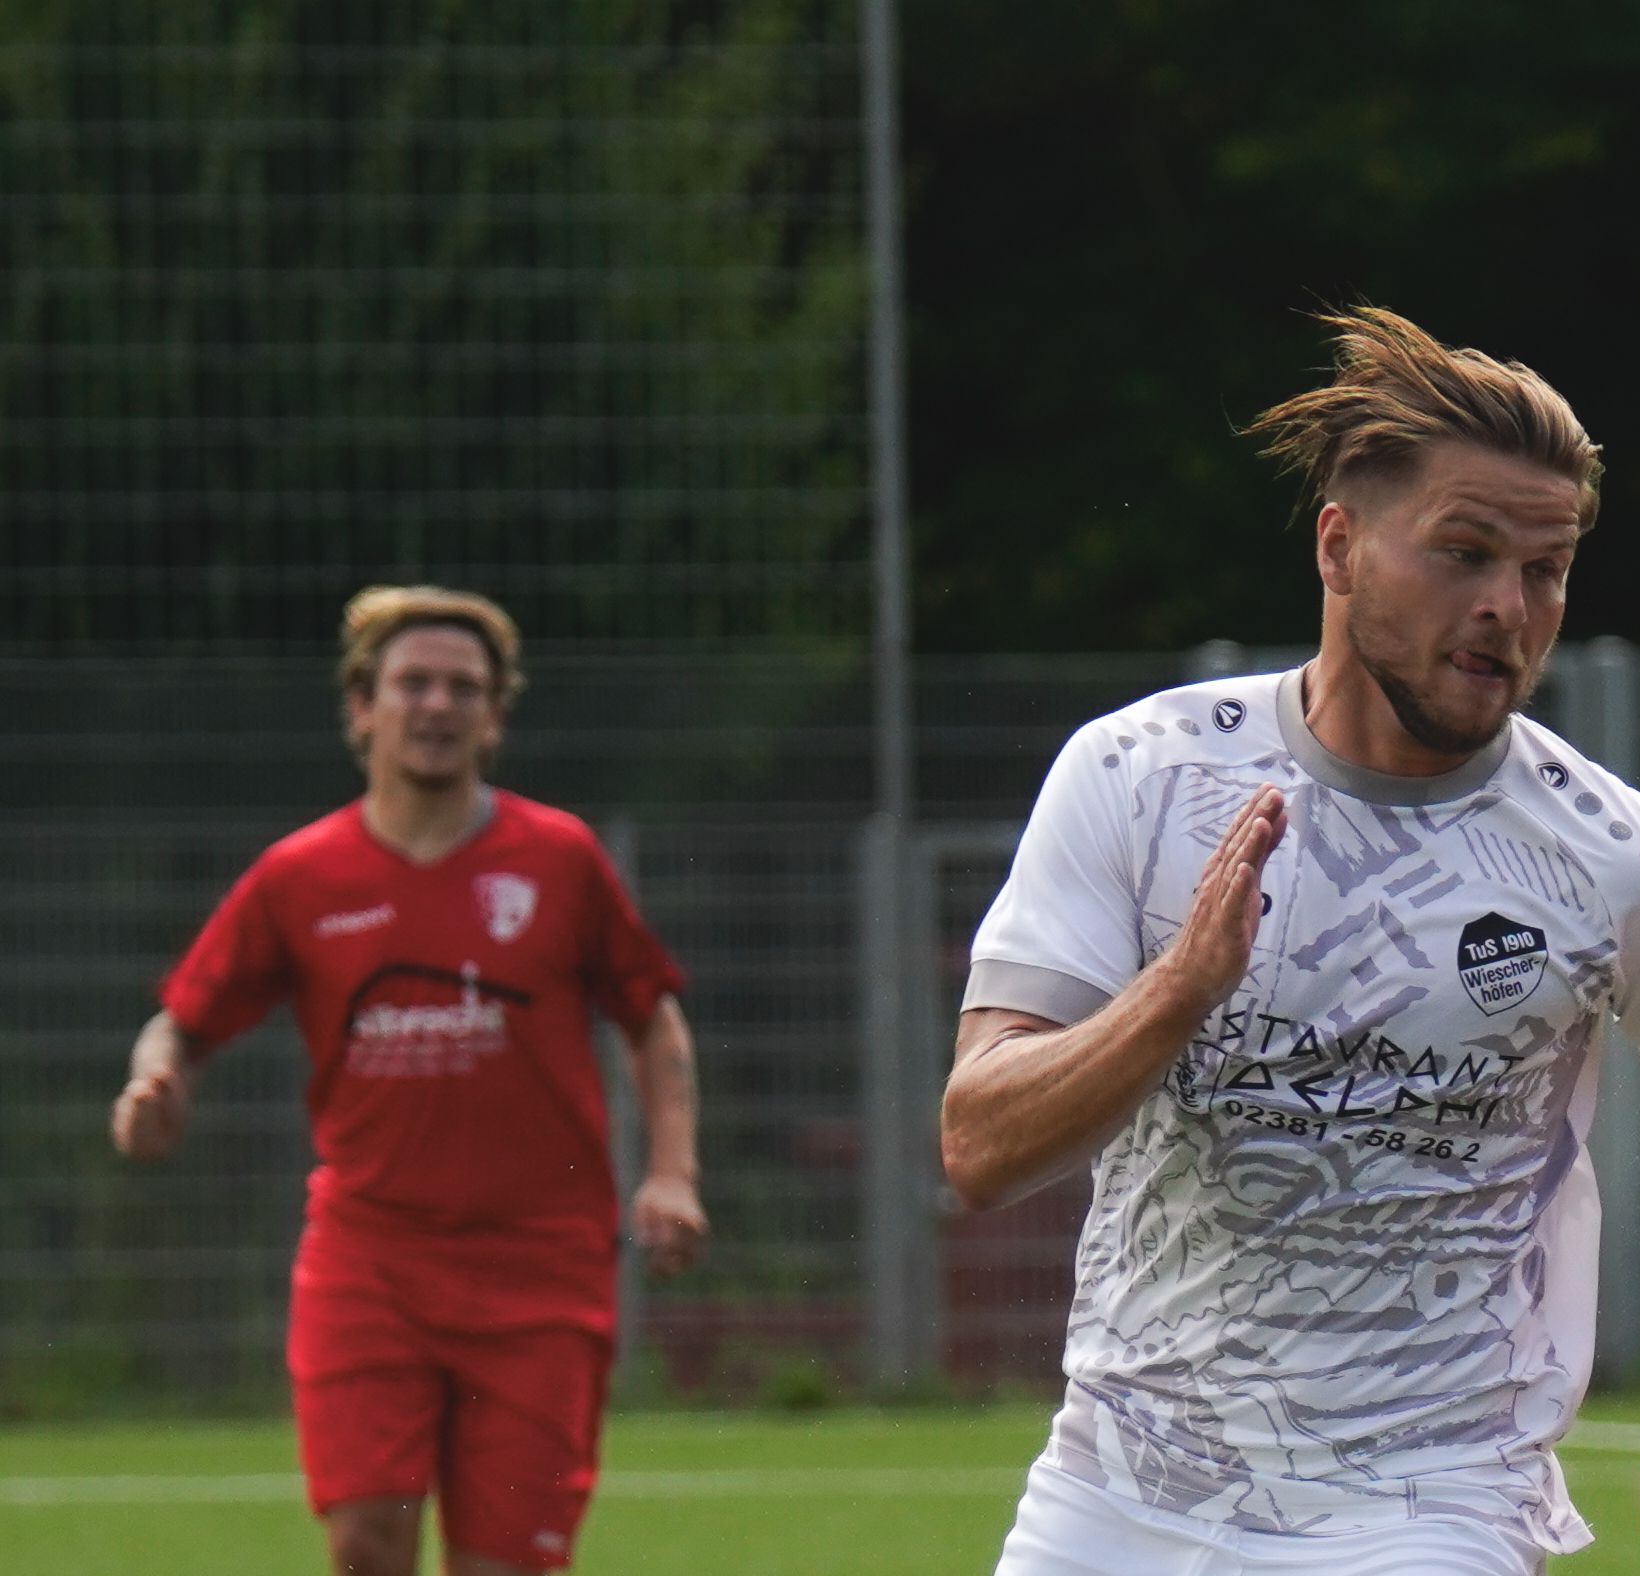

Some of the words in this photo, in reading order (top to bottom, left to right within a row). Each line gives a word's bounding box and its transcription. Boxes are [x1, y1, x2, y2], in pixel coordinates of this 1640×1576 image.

[1464, 938, 1499, 961] TuS
[1501, 931, 1536, 953] 1910
[1464, 956, 1540, 989] Wiescher-
[1480, 980, 1524, 1004] höfen
[1224, 1099, 1330, 1142] 02381
[1364, 1128, 1406, 1153] 58
[1414, 1136, 1453, 1160] 26
[1460, 1141, 1482, 1163] 2
